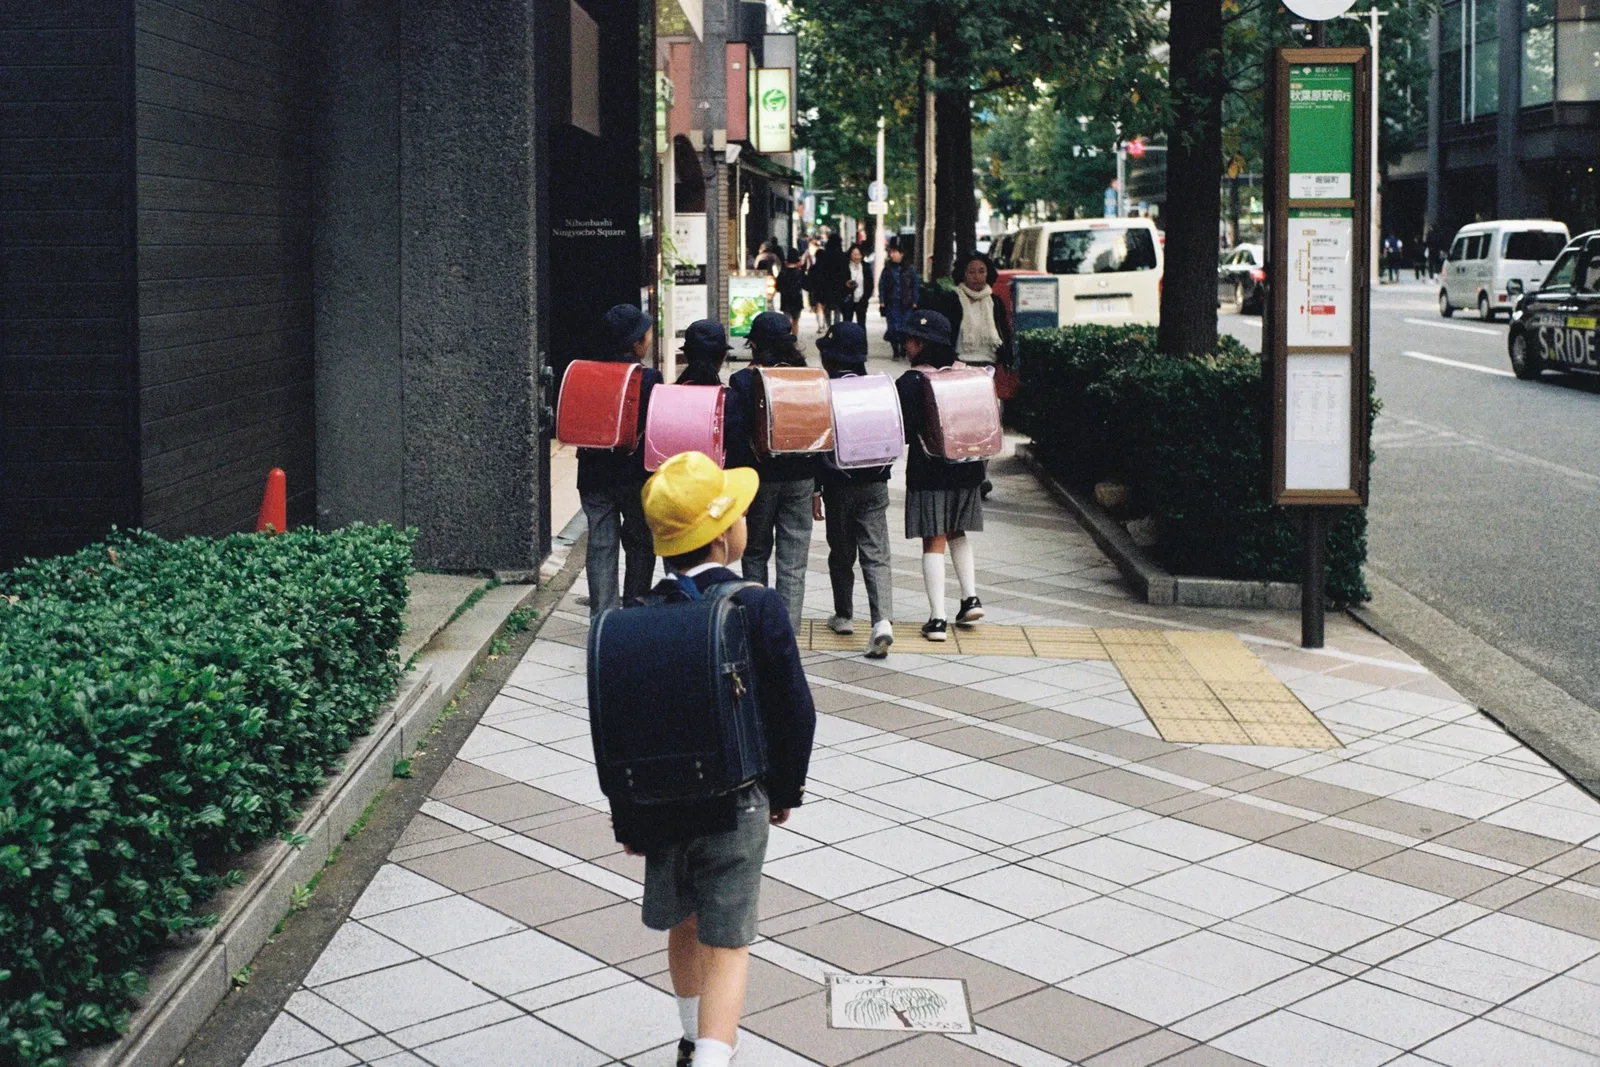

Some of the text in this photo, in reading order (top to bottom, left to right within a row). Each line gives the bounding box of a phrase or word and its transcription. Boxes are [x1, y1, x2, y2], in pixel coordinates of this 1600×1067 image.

[565, 218, 613, 227] Nihonbashi
[552, 228, 626, 238] Ningyocho Square
